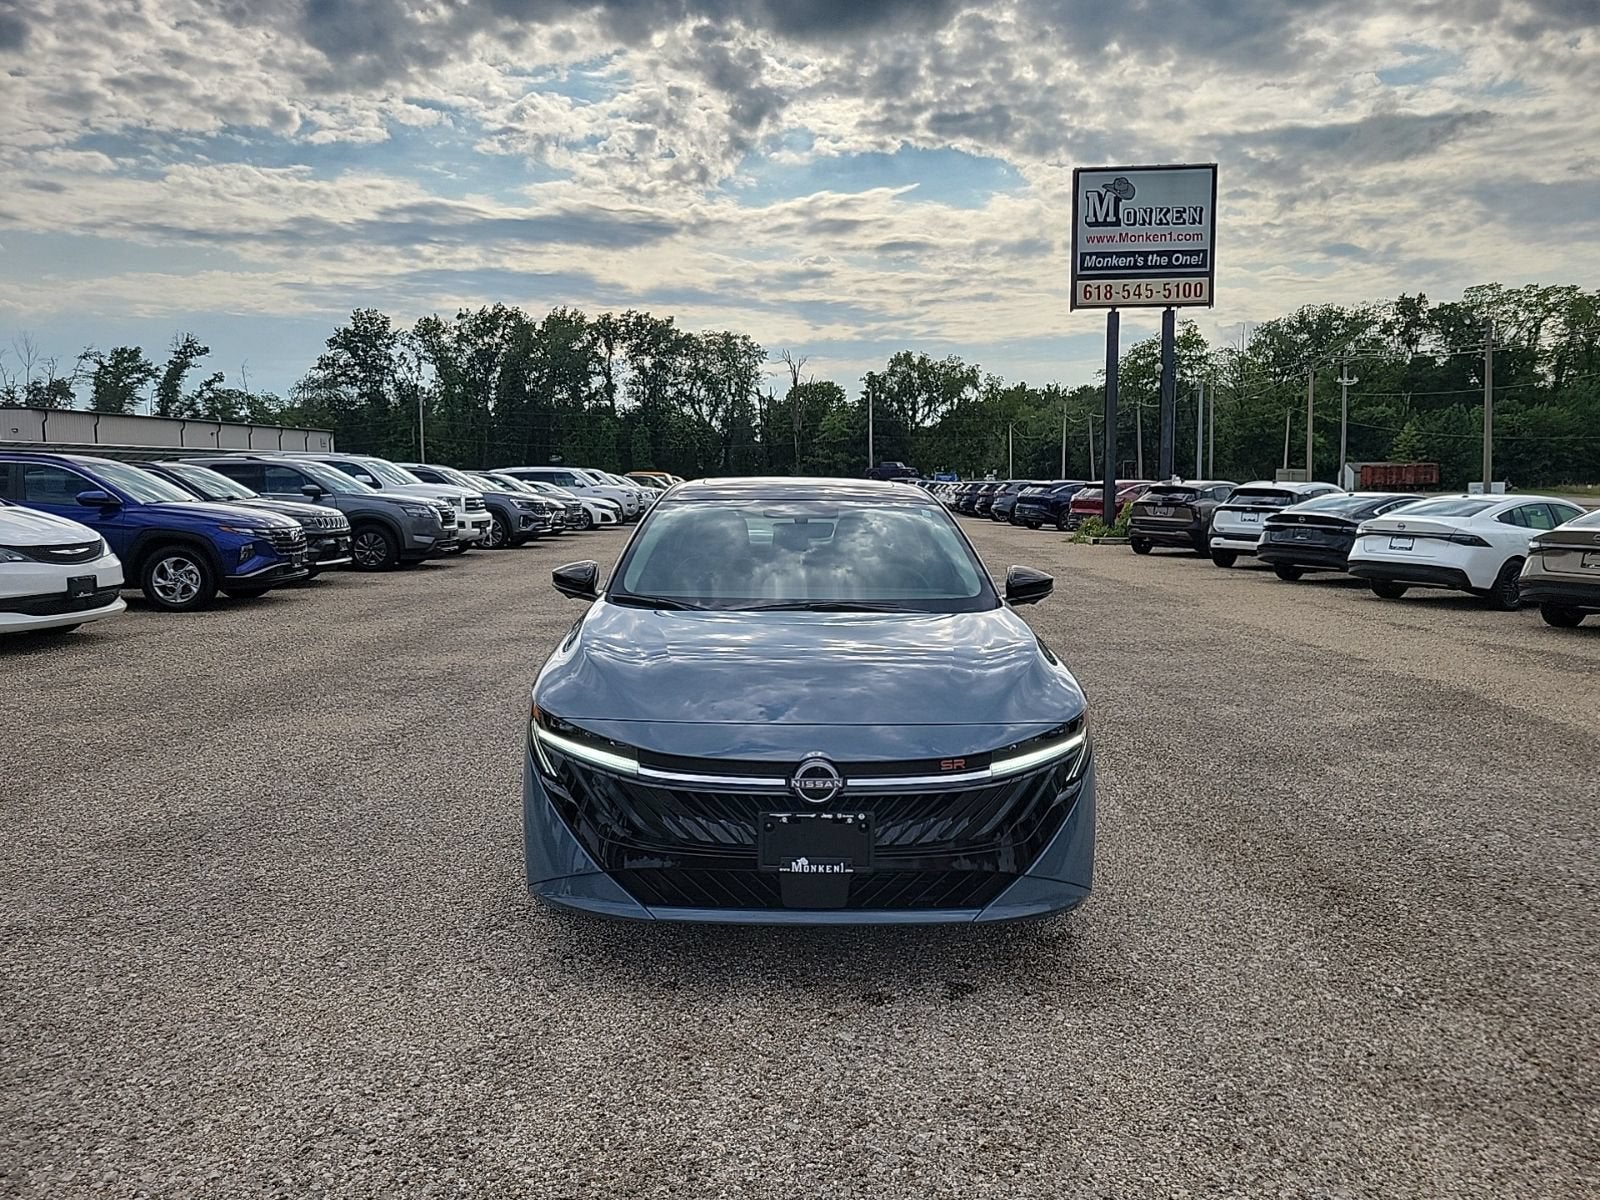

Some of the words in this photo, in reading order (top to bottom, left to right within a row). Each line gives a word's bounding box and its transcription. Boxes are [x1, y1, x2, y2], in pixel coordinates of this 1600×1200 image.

[1085, 190, 1204, 227] MONKEN
[1086, 231, 1203, 244] www.Monken1.com
[1084, 254, 1144, 267] Monken's
[1147, 254, 1168, 266] the
[1172, 253, 1203, 265] One!
[1083, 282, 1203, 300] 618-545-5100
[940, 759, 966, 770] SR
[791, 779, 843, 788] NISSAN
